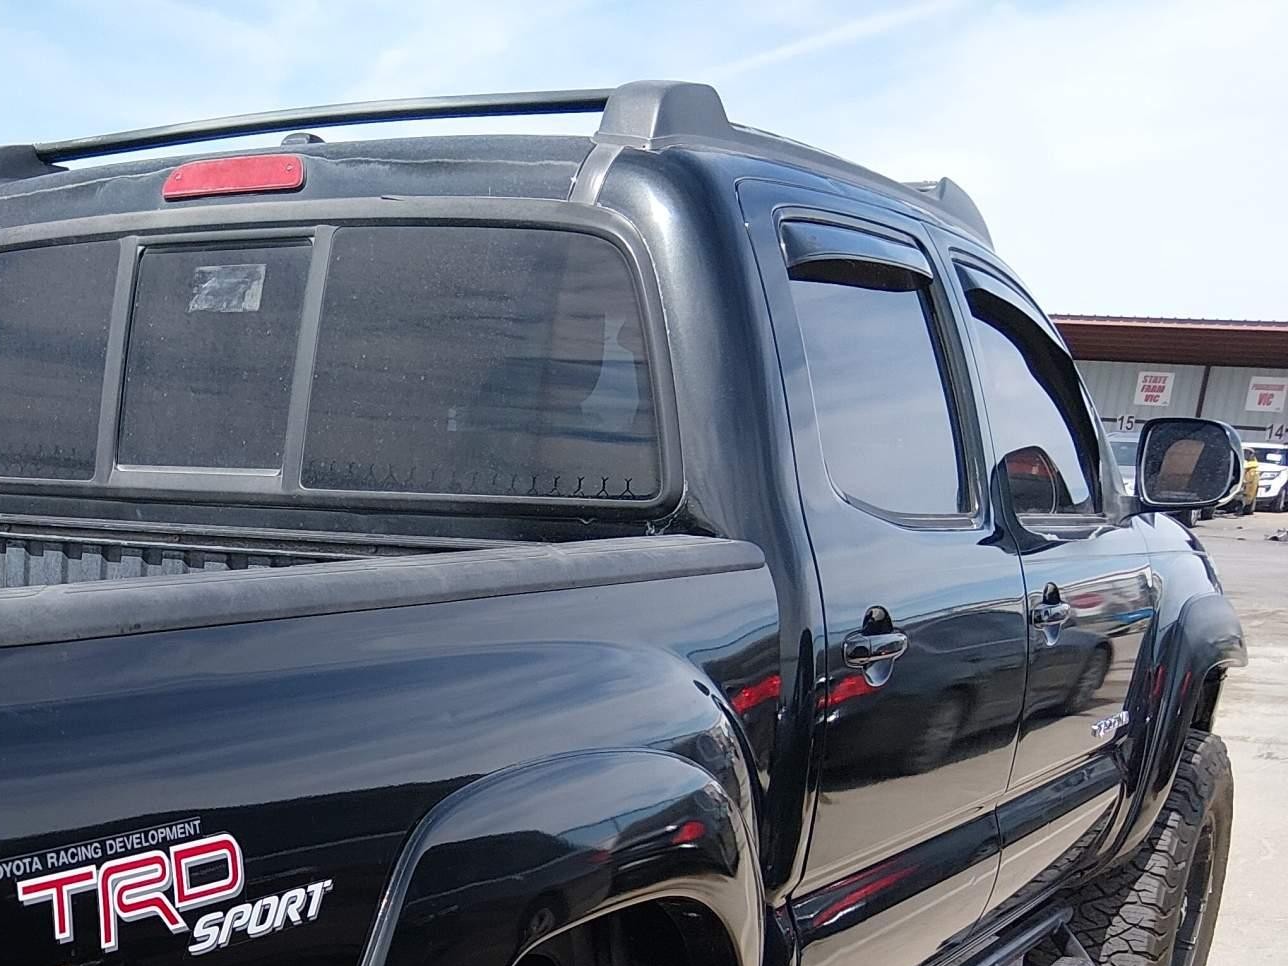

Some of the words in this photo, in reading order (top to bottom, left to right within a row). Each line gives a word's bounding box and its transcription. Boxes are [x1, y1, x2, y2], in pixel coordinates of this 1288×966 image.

[1117, 415, 1135, 431] 15
[1267, 423, 1284, 440] 14
[47, 842, 103, 869] RACING
[106, 819, 202, 855] DEVELOPMENT
[16, 831, 246, 953] TRD
[188, 878, 334, 956] SPORT
